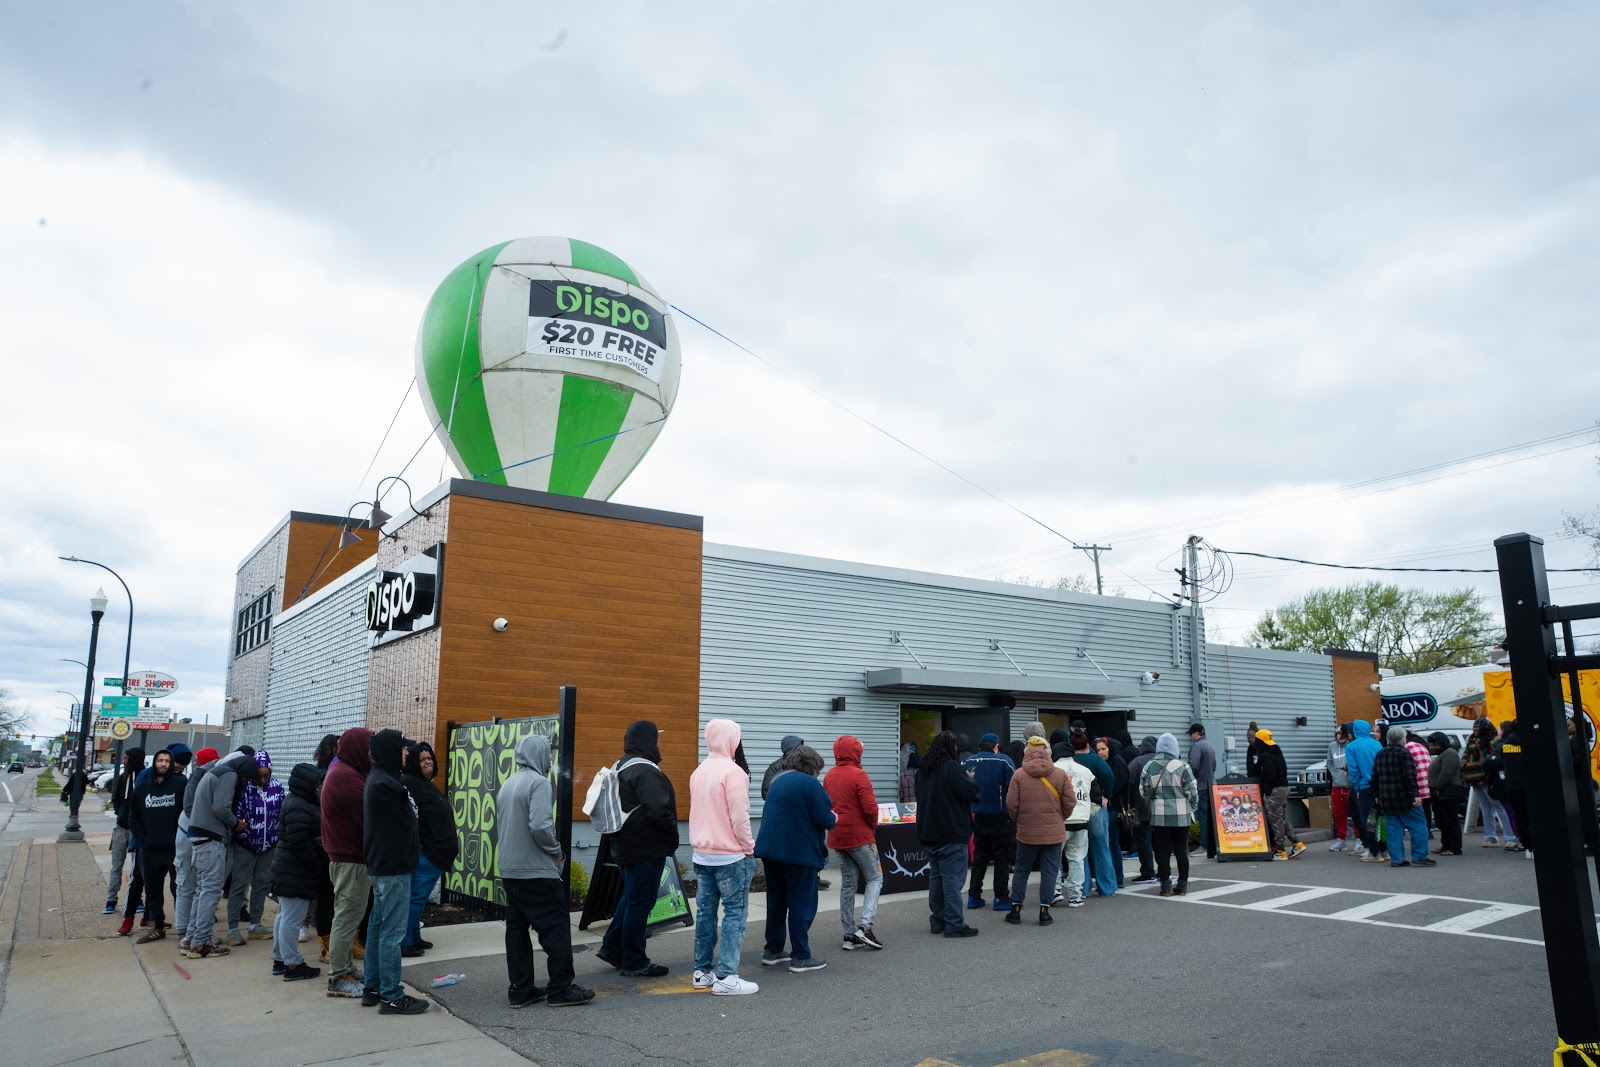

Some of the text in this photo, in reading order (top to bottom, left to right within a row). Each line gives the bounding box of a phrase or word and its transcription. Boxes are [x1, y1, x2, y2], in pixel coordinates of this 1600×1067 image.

[556, 285, 650, 331] Dispo
[541, 320, 657, 367] $20 FREE
[549, 345, 649, 375] FIRST TIME CUSTOMERS
[365, 570, 416, 630] Dispo
